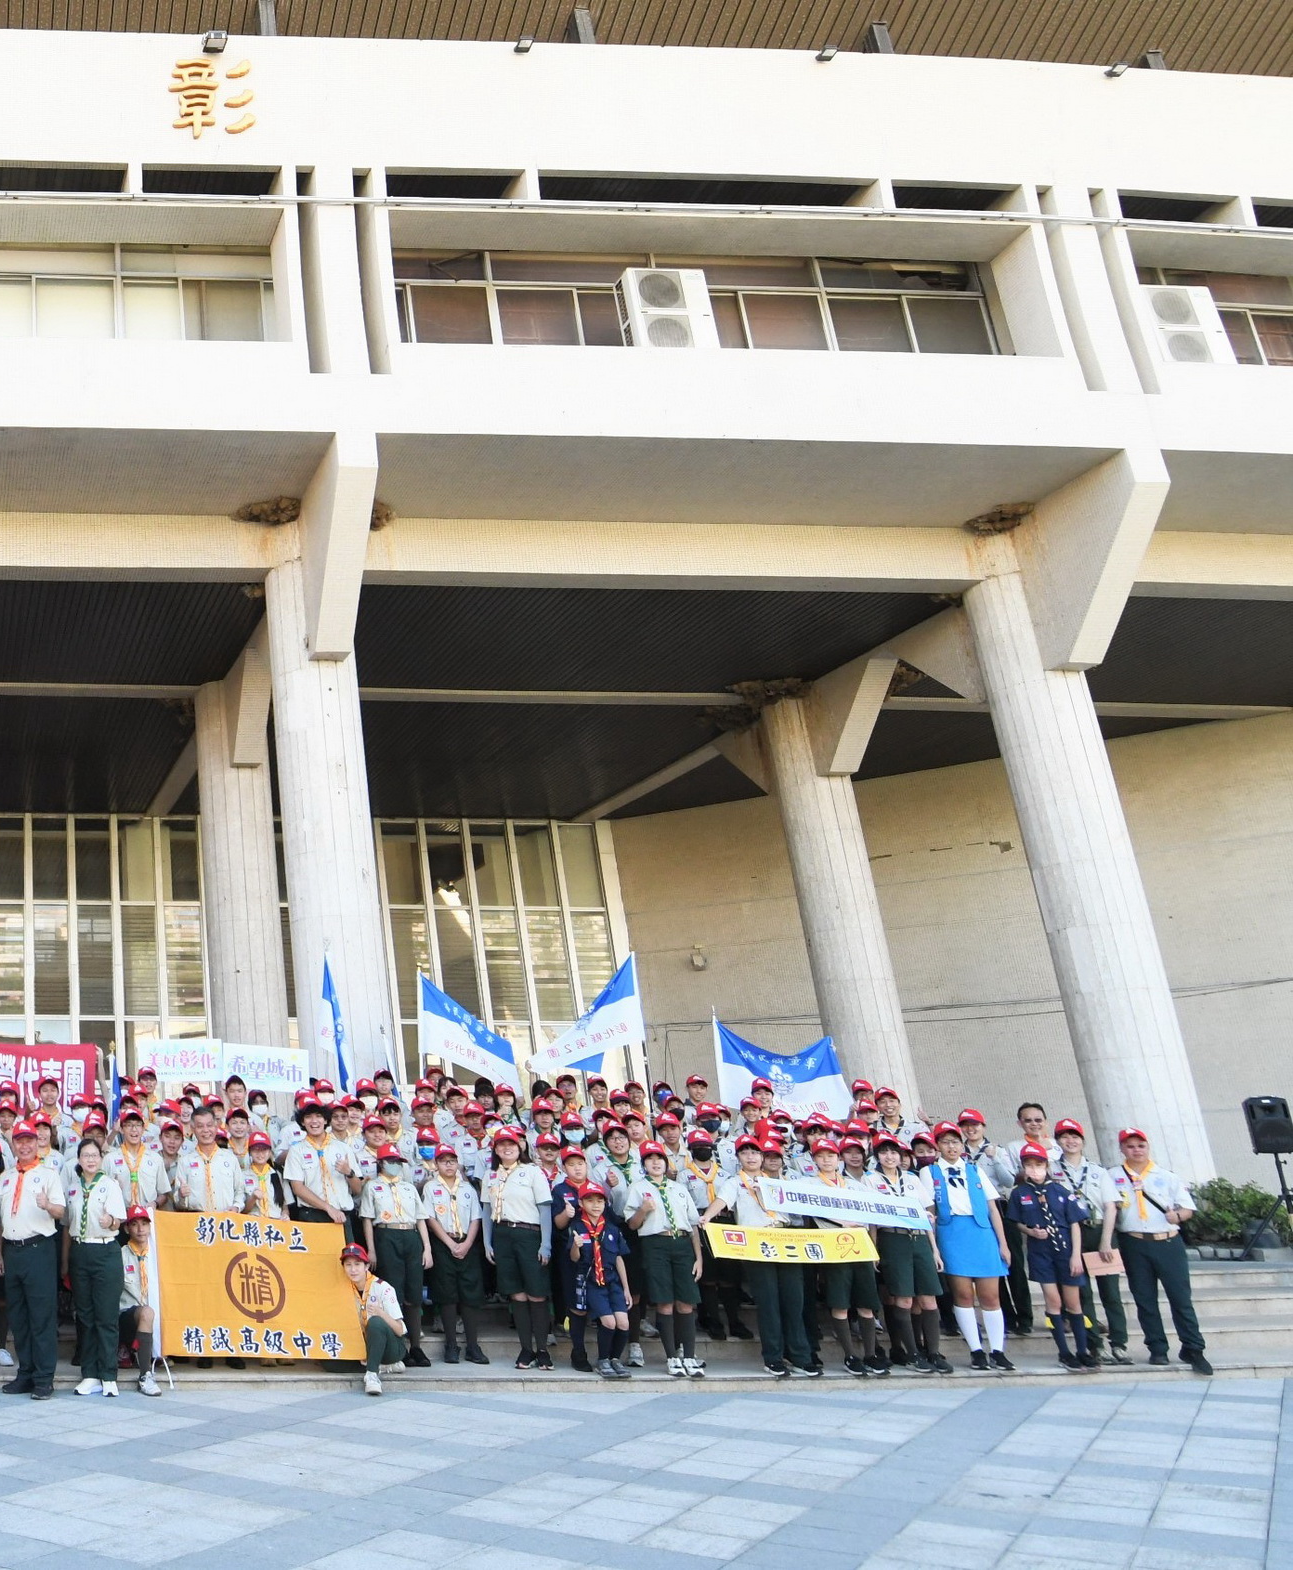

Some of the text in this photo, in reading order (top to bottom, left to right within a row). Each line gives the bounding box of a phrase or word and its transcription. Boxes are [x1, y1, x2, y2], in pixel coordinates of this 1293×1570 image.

[149, 1050, 217, 1069] 美好彰化
[232, 1055, 303, 1083] 希望城市
[195, 1216, 307, 1252] 彰化縣私立
[183, 1326, 342, 1357] 精誠高級中學
